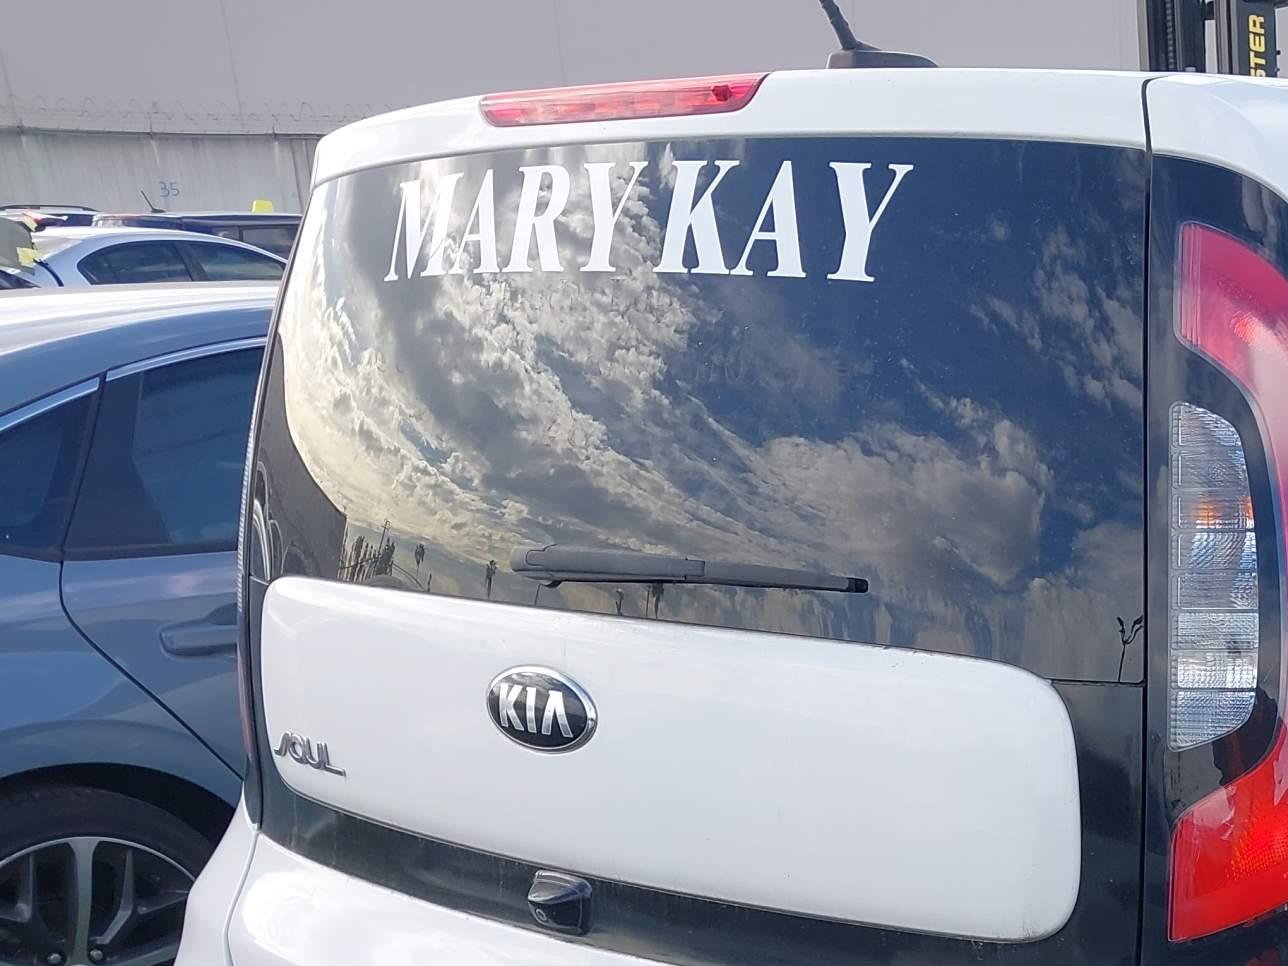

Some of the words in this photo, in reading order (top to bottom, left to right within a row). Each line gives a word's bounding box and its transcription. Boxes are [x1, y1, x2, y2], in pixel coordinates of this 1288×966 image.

[158, 181, 181, 198] 35
[384, 161, 648, 282] MARY
[653, 160, 914, 282] KAY
[498, 684, 573, 739] KIA
[273, 731, 346, 777] SOUL
